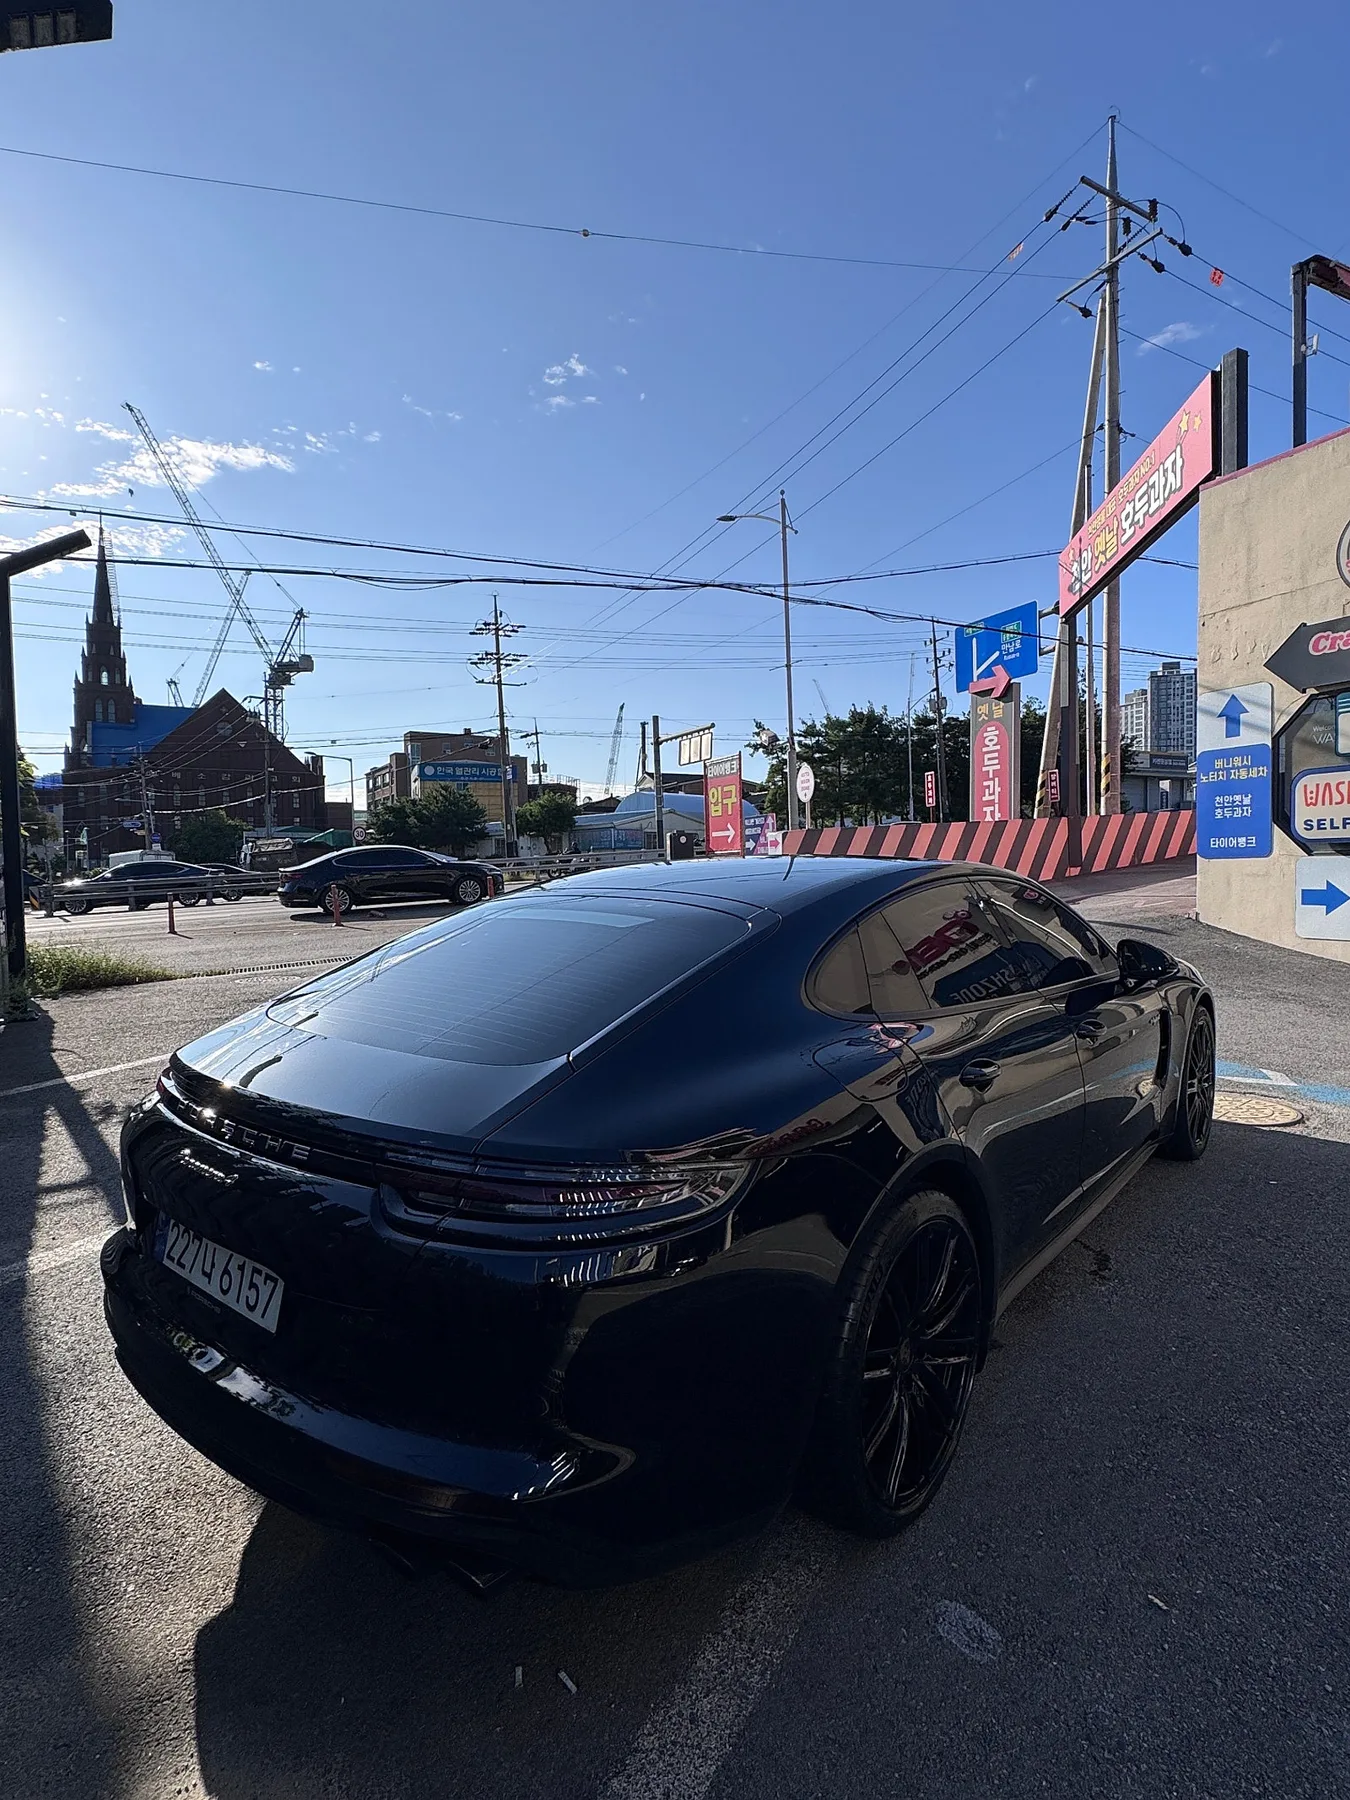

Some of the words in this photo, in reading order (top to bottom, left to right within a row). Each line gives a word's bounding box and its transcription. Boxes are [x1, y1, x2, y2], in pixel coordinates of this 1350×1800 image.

[1094, 517, 1118, 572] 옛날
[1120, 444, 1183, 545] 호두과자
[1001, 639, 1022, 654] 만남로
[976, 702, 1004, 721] 옛날
[1214, 755, 1251, 769] 버니워시
[981, 726, 1001, 821] 호두과자
[1200, 770, 1226, 783] 노터치
[1230, 765, 1268, 780] 자동세차
[708, 784, 738, 818] 입구
[1214, 793, 1252, 807] 천안옛날
[1303, 780, 1350, 807] WAS
[1214, 806, 1252, 819] 호두과자
[1303, 817, 1350, 831] SELF
[355, 829, 364, 838] 30
[1210, 836, 1257, 848] 타이어뱅크
[219, 1252, 279, 1320] 6157
